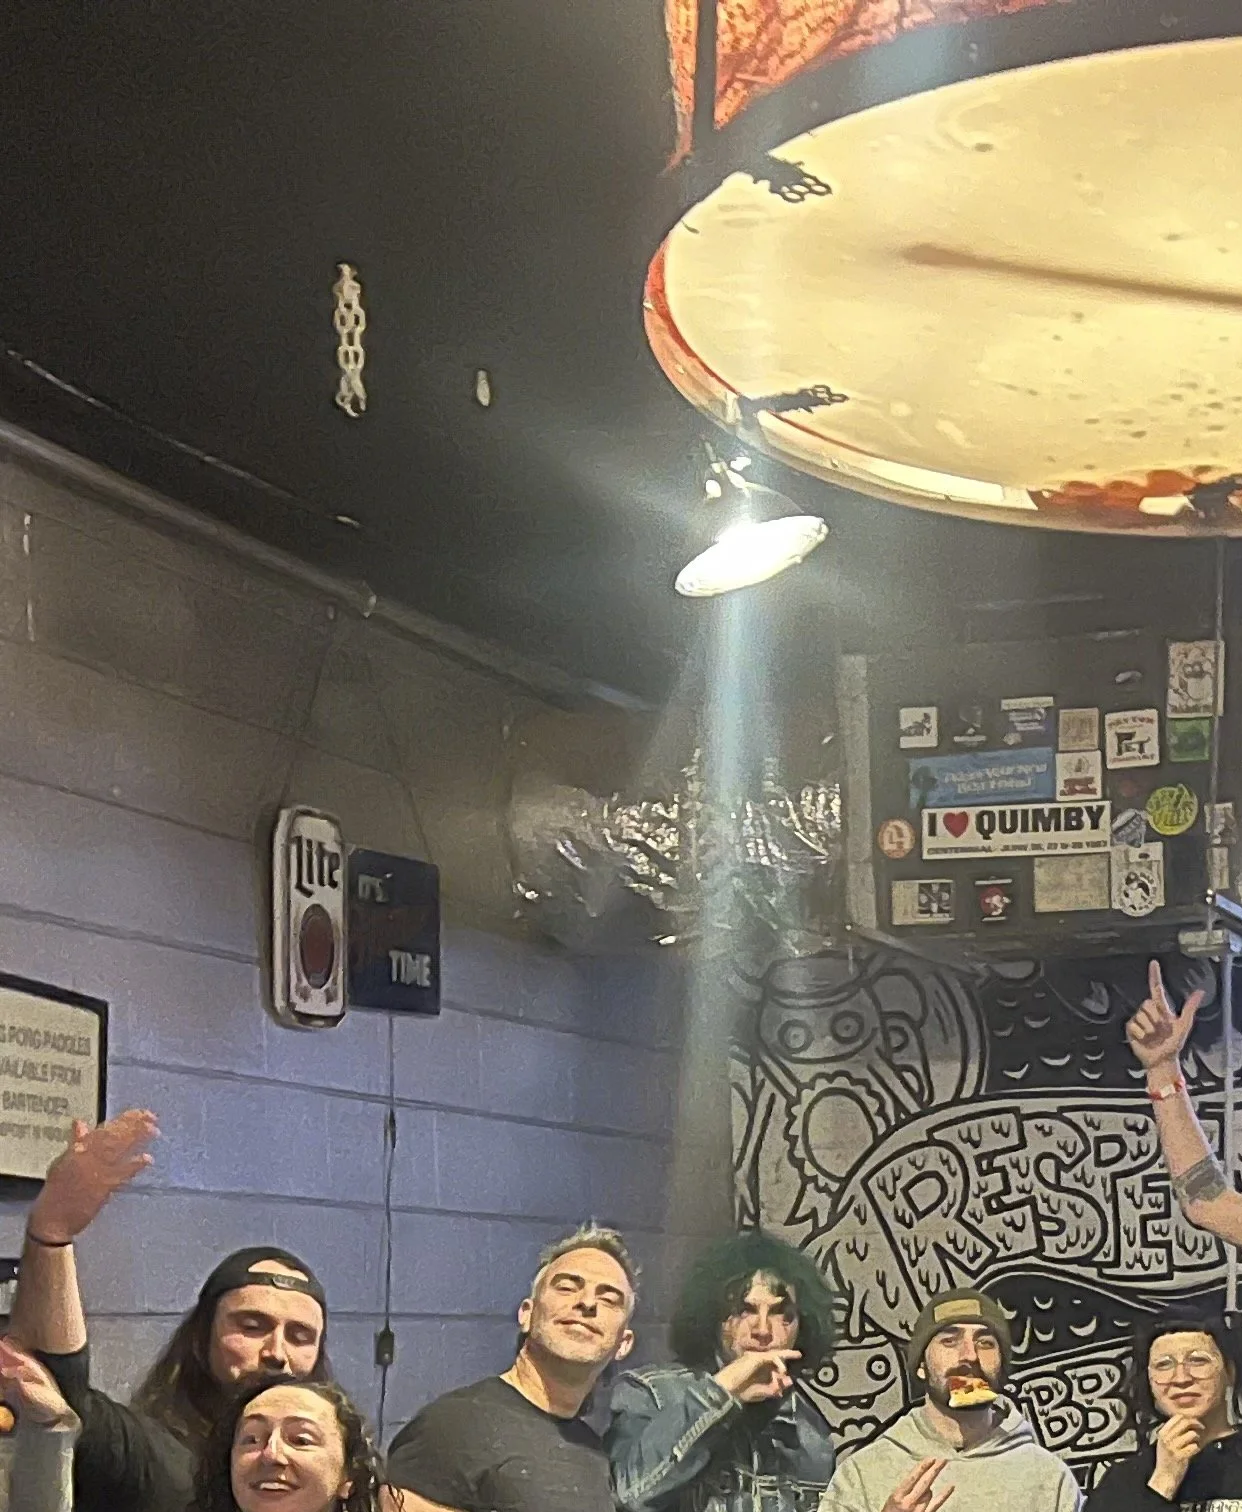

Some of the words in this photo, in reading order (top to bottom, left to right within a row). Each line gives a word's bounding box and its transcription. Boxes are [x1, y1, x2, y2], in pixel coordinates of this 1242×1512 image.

[928, 812, 937, 837] I
[975, 805, 1106, 841] QUIMBY
[293, 834, 341, 898] Lite
[388, 949, 432, 988] TIME
[8, 1026, 42, 1050] PONG
